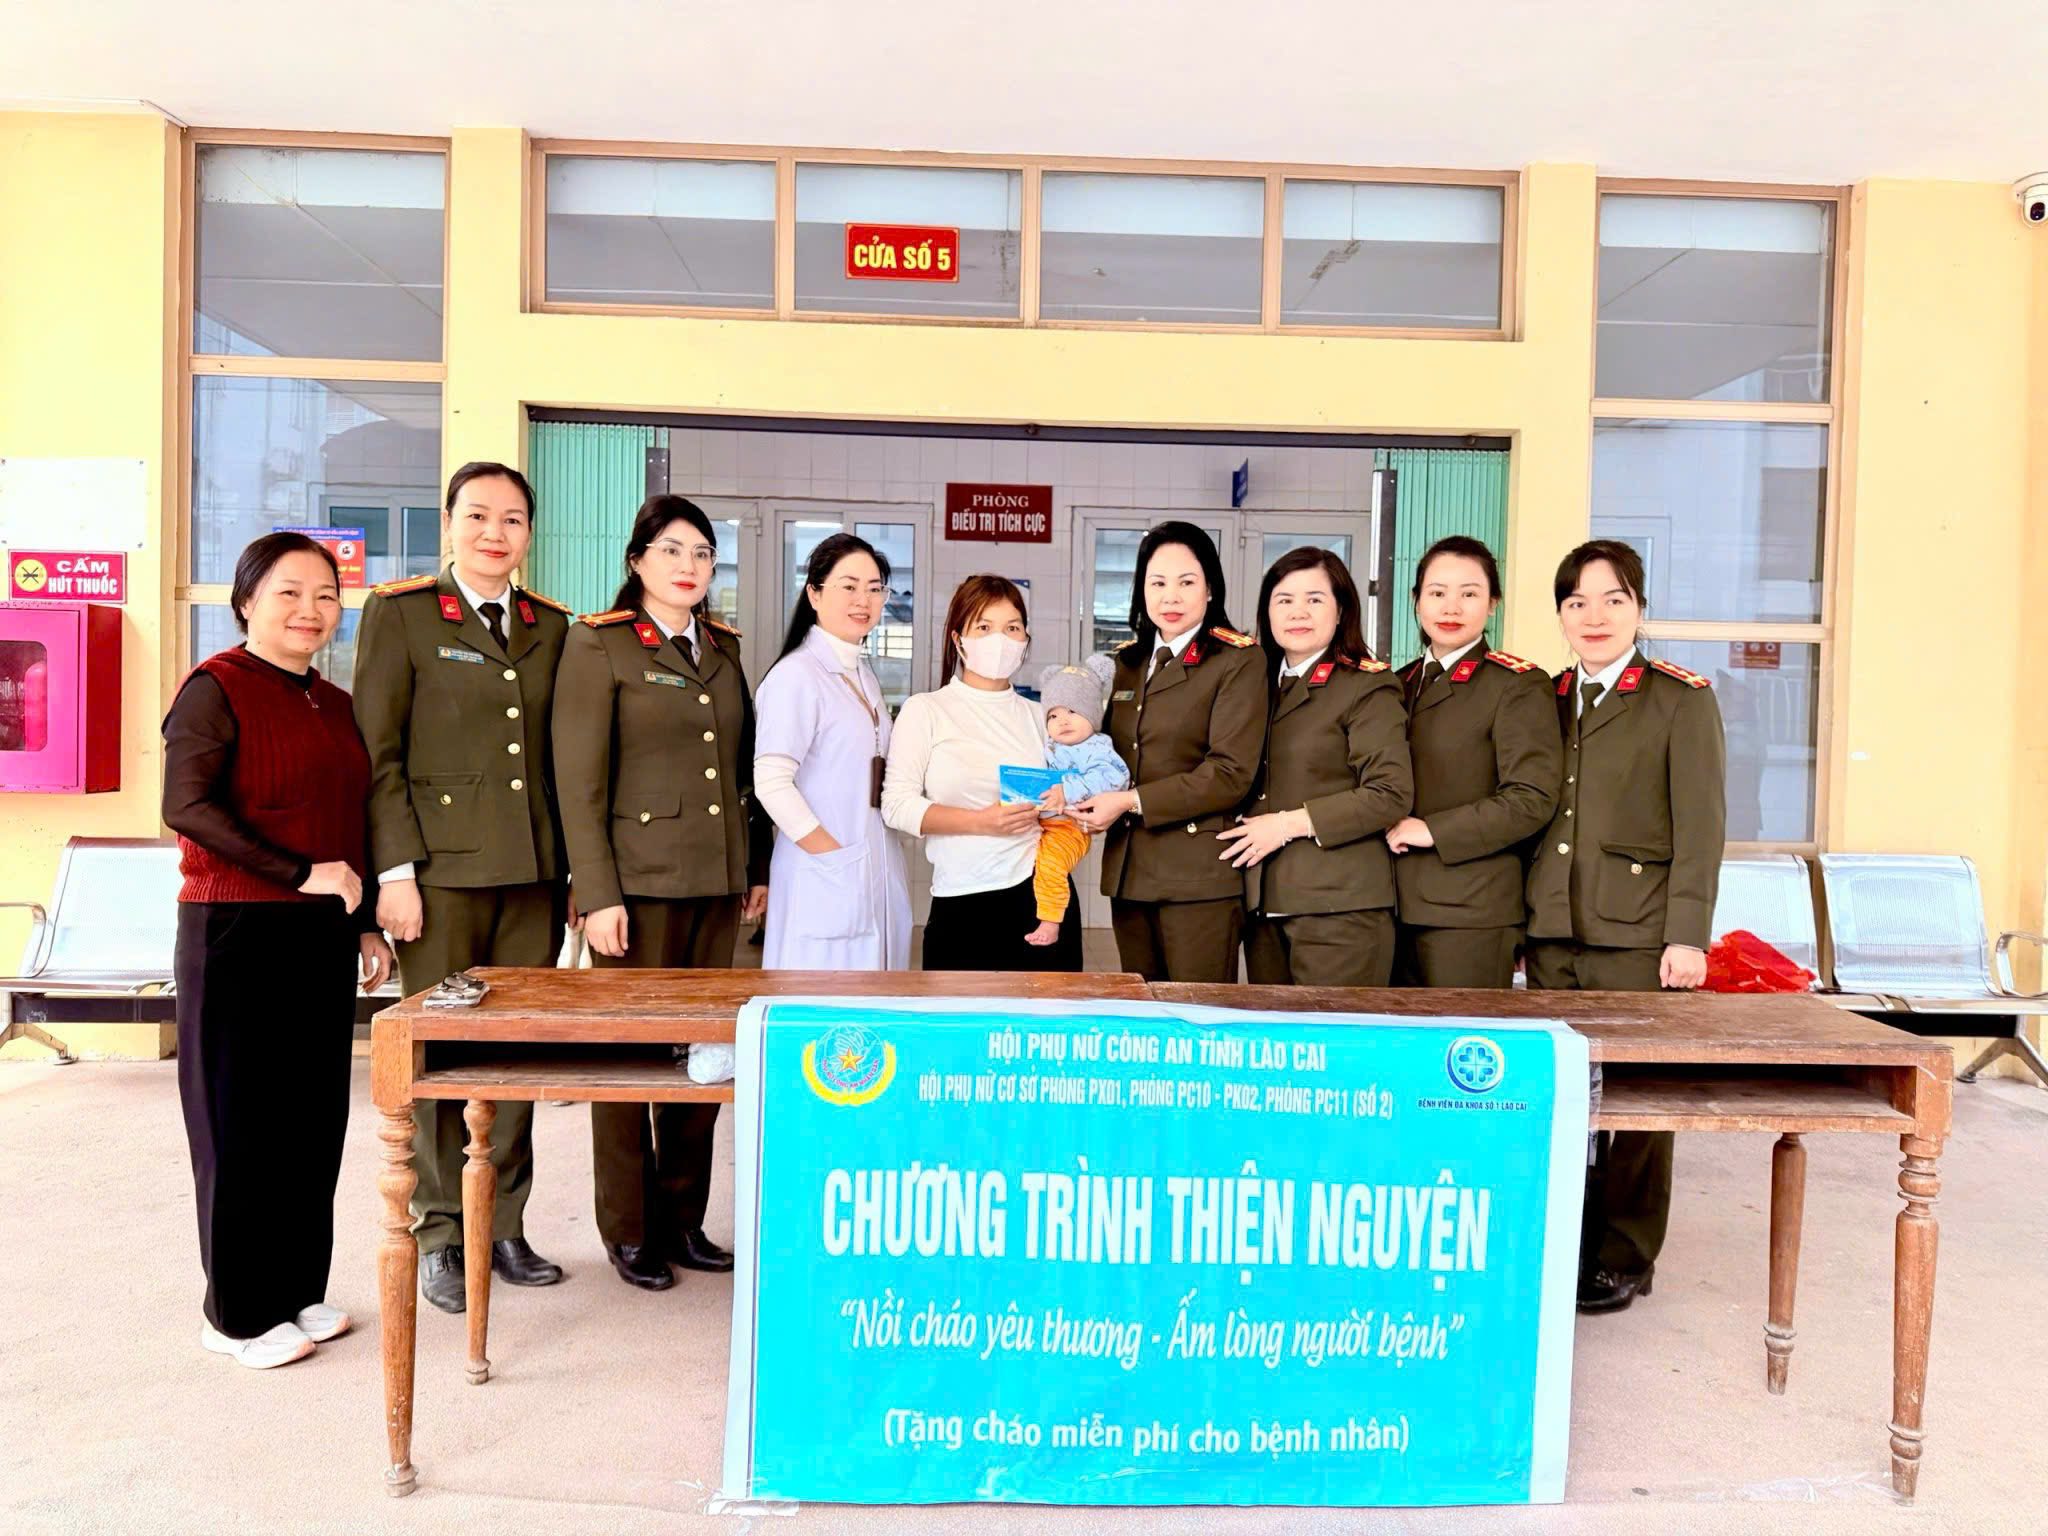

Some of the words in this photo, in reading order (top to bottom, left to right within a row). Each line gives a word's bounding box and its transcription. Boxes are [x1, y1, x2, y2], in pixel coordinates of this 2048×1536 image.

[854, 235, 897, 269] CỬA
[903, 238, 933, 270] SỐ
[937, 247, 951, 271] 5
[972, 492, 1029, 507] PHÒNG
[979, 512, 995, 535] TRỊ
[998, 509, 1022, 532] TÍCH
[1024, 512, 1046, 536] CỰC
[56, 556, 110, 573] CẤM
[48, 575, 73, 593] HÚT
[76, 573, 118, 595] THUỐC
[988, 1026, 1021, 1064] HỘI
[1027, 1032, 1067, 1066] PHỤ
[1072, 1027, 1103, 1061] NỮ
[1107, 1030, 1160, 1062] CÔNG
[1165, 1037, 1193, 1064] AN
[1199, 1031, 1244, 1068] TỈNH
[1249, 1037, 1287, 1070] LÀO
[1293, 1042, 1326, 1071] CAI
[919, 1069, 941, 1107] HỘI
[945, 1074, 972, 1107] PHỤ
[975, 1069, 996, 1102] NỮ
[998, 1074, 1016, 1102] CƠ
[1019, 1064, 1038, 1103] SỞ
[1040, 1071, 1085, 1104] PHÒNG
[1088, 1078, 1126, 1109] PX01,
[1130, 1073, 1174, 1105] PHÒNG
[1178, 1081, 1211, 1108] PC10
[1224, 1083, 1262, 1112] PK02,
[1265, 1080, 1312, 1114] PHÒNG
[1315, 1088, 1348, 1116] PC11
[1353, 1083, 1377, 1120] (SỐ
[1379, 1090, 1393, 1120] 2)
[1454, 1101, 1464, 1109] ĐA
[1465, 1101, 1483, 1110] KHOA
[1515, 1103, 1527, 1112] CAI
[823, 1160, 1007, 1257] CHƯƠNG
[1021, 1154, 1152, 1264] TRÌNH
[1167, 1160, 1295, 1285] THIỆN
[1307, 1168, 1491, 1291] NGUYỆN
[909, 1299, 977, 1348] cháo
[980, 1300, 1035, 1361] yêu
[1042, 1307, 1143, 1371] thương
[1167, 1287, 1216, 1360] Ấm
[1223, 1307, 1285, 1369] lòng
[1290, 1307, 1373, 1368] người
[884, 1408, 964, 1450] (Tặng
[973, 1409, 1041, 1447] cháo
[1052, 1413, 1123, 1448] miễn
[1133, 1420, 1179, 1457] phí
[1189, 1420, 1241, 1453] cho
[1252, 1415, 1320, 1463] bệnh
[1330, 1415, 1409, 1454] nhân)
